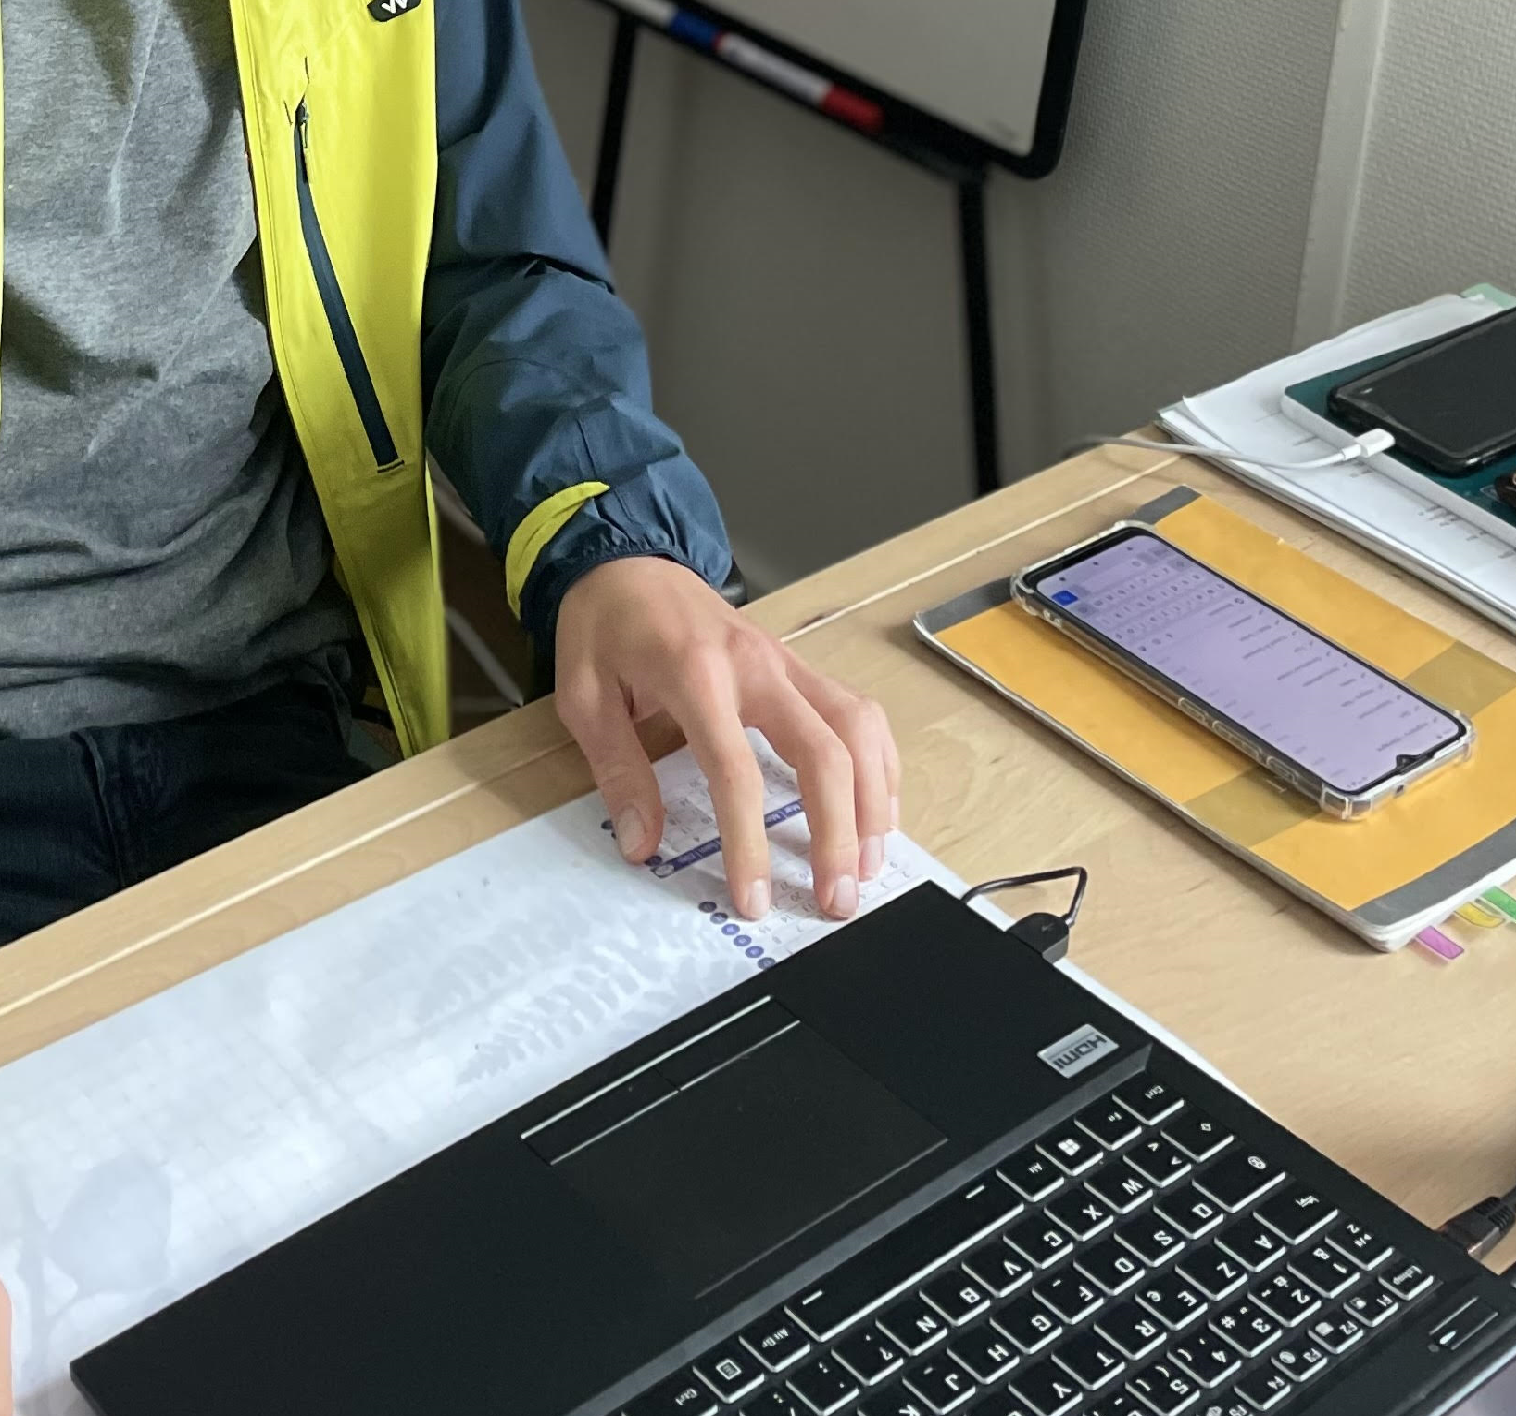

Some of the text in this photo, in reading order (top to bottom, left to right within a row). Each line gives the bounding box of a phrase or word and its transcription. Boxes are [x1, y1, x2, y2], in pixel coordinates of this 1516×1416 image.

[1053, 1035, 1107, 1069] HDMI
[1121, 1178, 1145, 1196] W
[1082, 1204, 1103, 1221] X
[1043, 1230, 1063, 1247] C
[1153, 1229, 1173, 1247] S
[1254, 1234, 1273, 1250] A
[1003, 1260, 1022, 1276] V
[1114, 1256, 1135, 1273] D
[1216, 1261, 1237, 1279] Z
[959, 1286, 981, 1304] B
[1078, 1285, 1094, 1302] F
[1177, 1290, 1198, 1307] E
[1290, 1288, 1311, 1304] 2
[915, 1315, 938, 1333] N
[1031, 1314, 1052, 1332] G
[1134, 1319, 1157, 1338] R
[1251, 1317, 1272, 1334] 3
[987, 1344, 1010, 1362] H
[1096, 1351, 1115, 1367] T
[1211, 1350, 1227, 1363] 4
[944, 1373, 960, 1391] J
[1052, 1382, 1072, 1399] Y
[1169, 1378, 1189, 1395] 5
